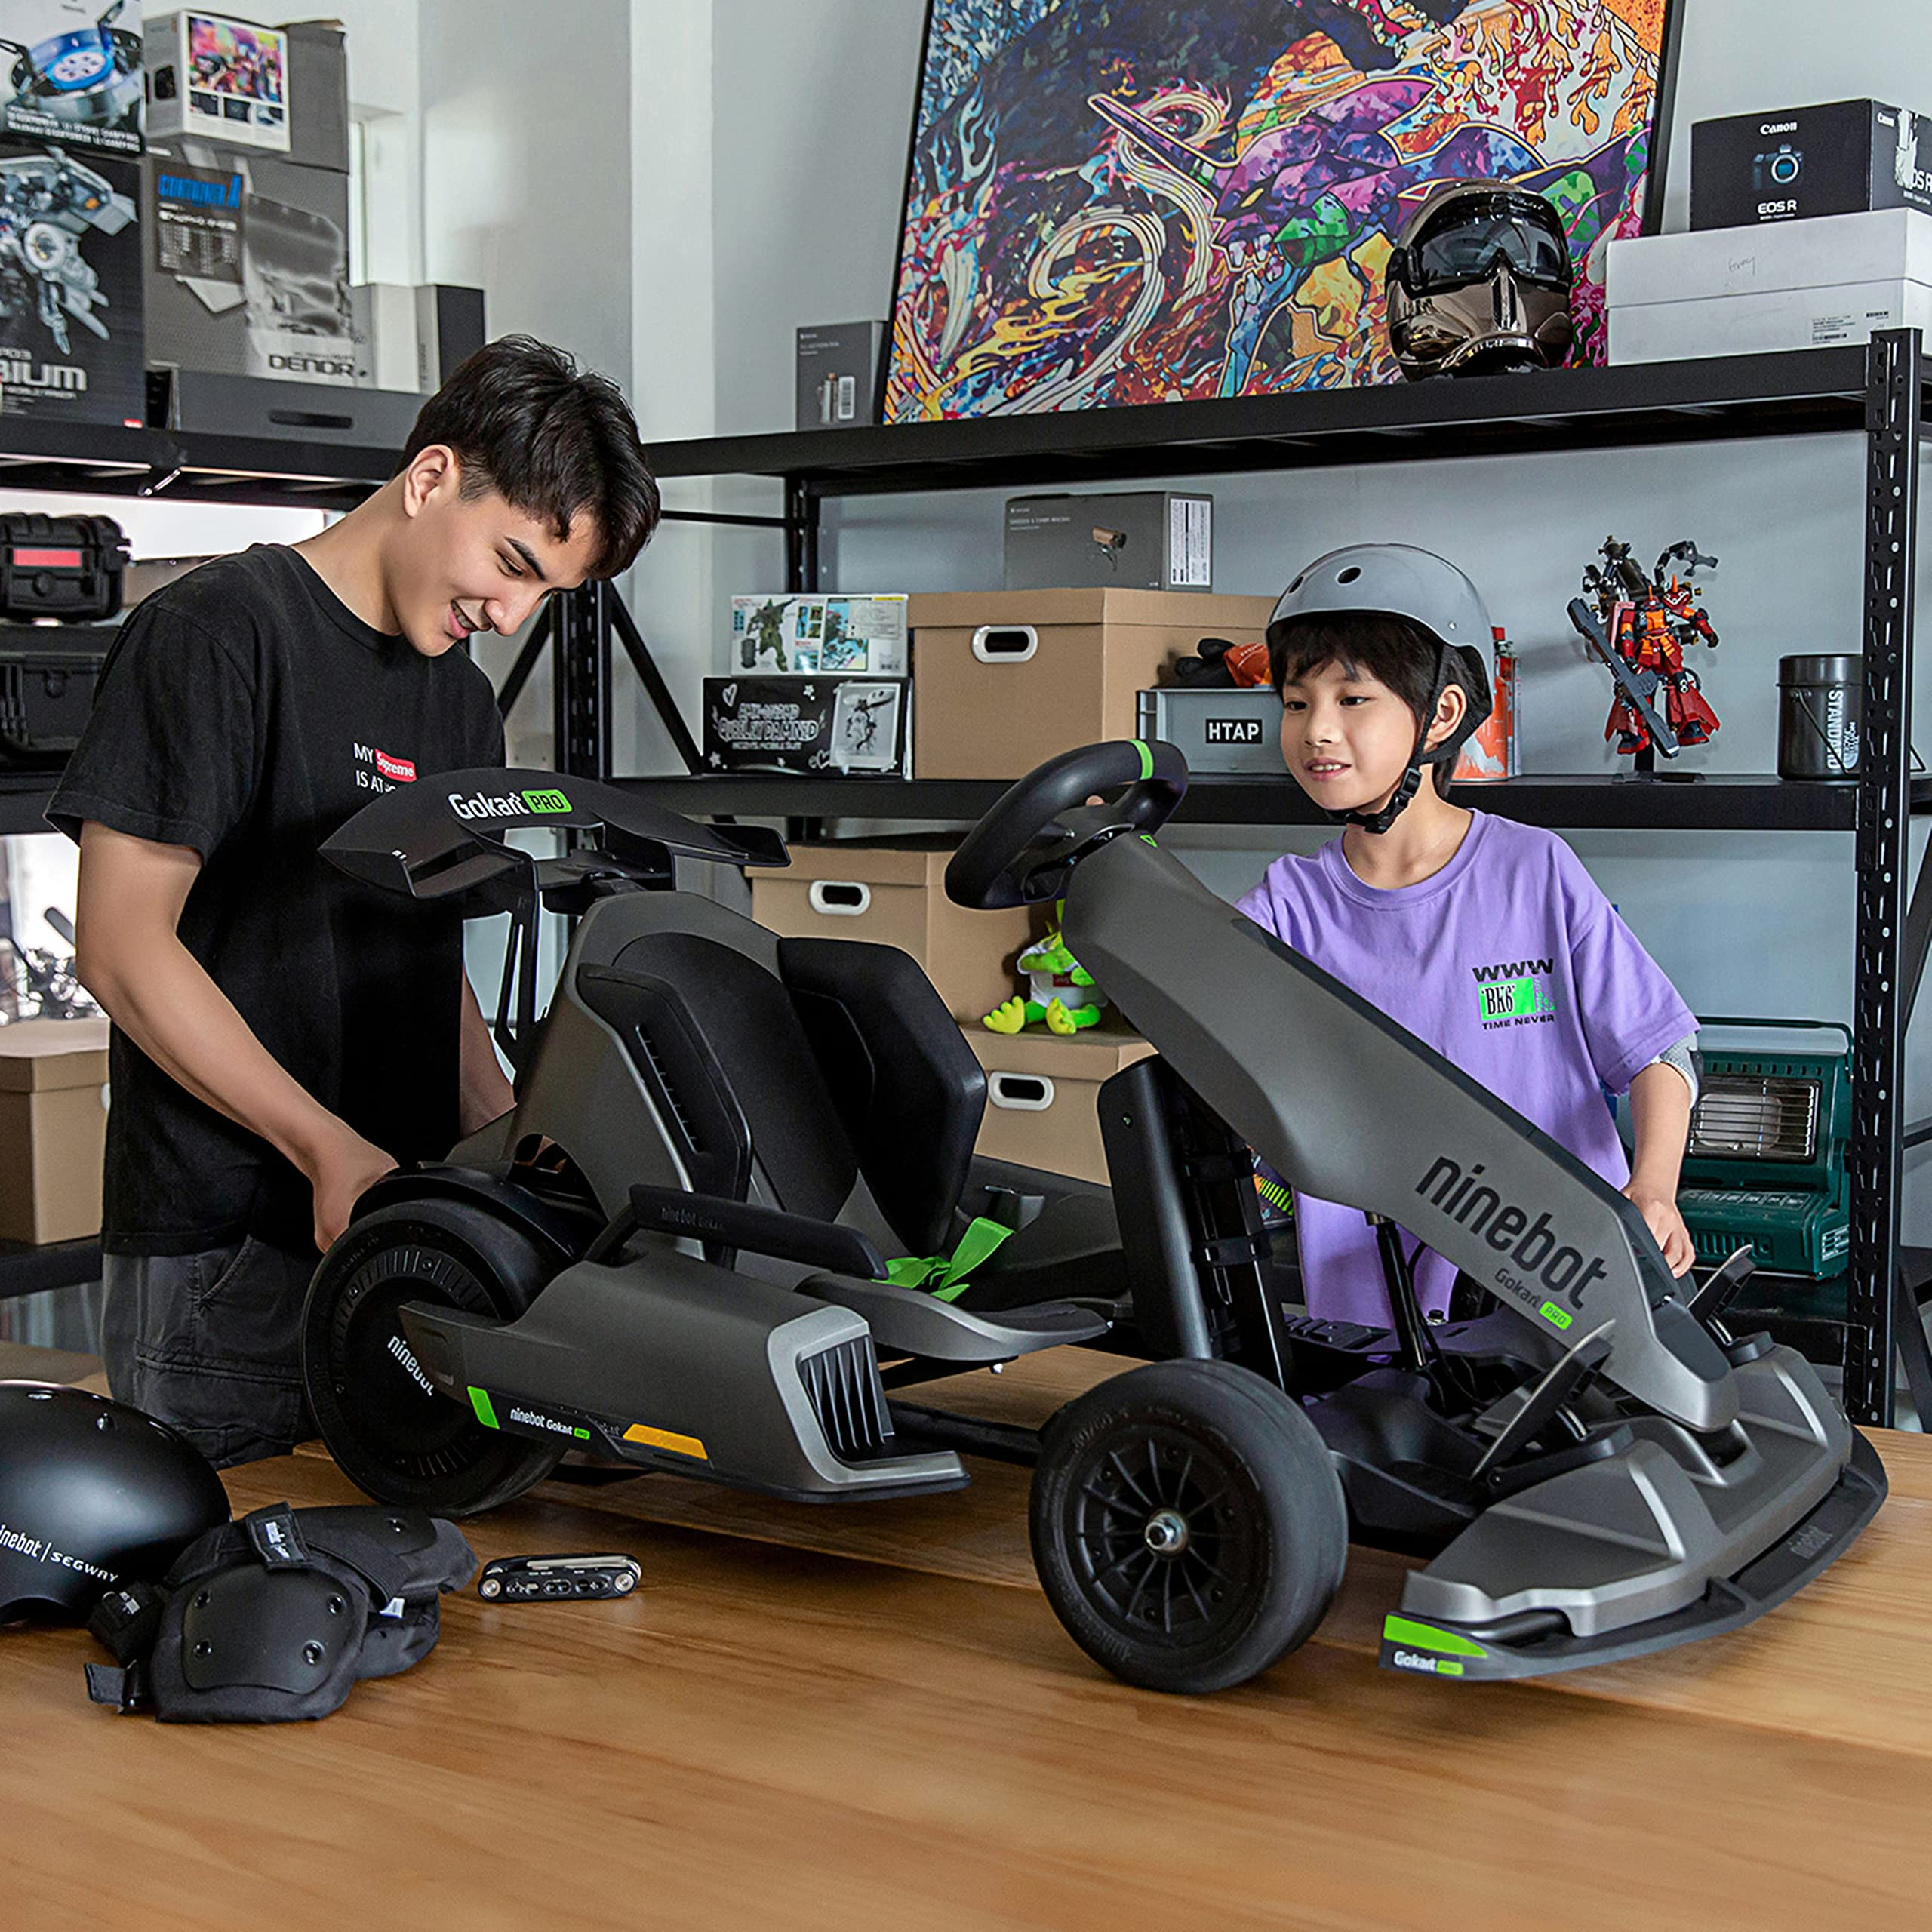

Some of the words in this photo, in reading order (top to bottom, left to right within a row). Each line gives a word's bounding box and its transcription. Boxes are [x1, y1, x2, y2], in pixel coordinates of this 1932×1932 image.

[1759, 121, 1798, 136] Canon
[1757, 201, 1786, 214] EOS
[1786, 199, 1798, 211] R
[1208, 722, 1260, 740] HTAP
[353, 742, 374, 764] MY
[355, 769, 369, 788] IS
[448, 792, 530, 820] Gokart
[530, 795, 565, 810] PRO
[1472, 958, 1554, 982] WWW
[1482, 1020, 1511, 1030] TIME
[1515, 1014, 1555, 1026] NEVER
[1415, 1155, 1607, 1310] ninebot
[1494, 1268, 1542, 1309] Gokart
[1545, 1305, 1567, 1326] PRO
[510, 1407, 545, 1428] ninebot
[546, 1419, 573, 1435] Gokart
[0, 1524, 42, 1558] inebot
[50, 1552, 119, 1582] SEGWAY
[1393, 1651, 1436, 1672] Gokart
